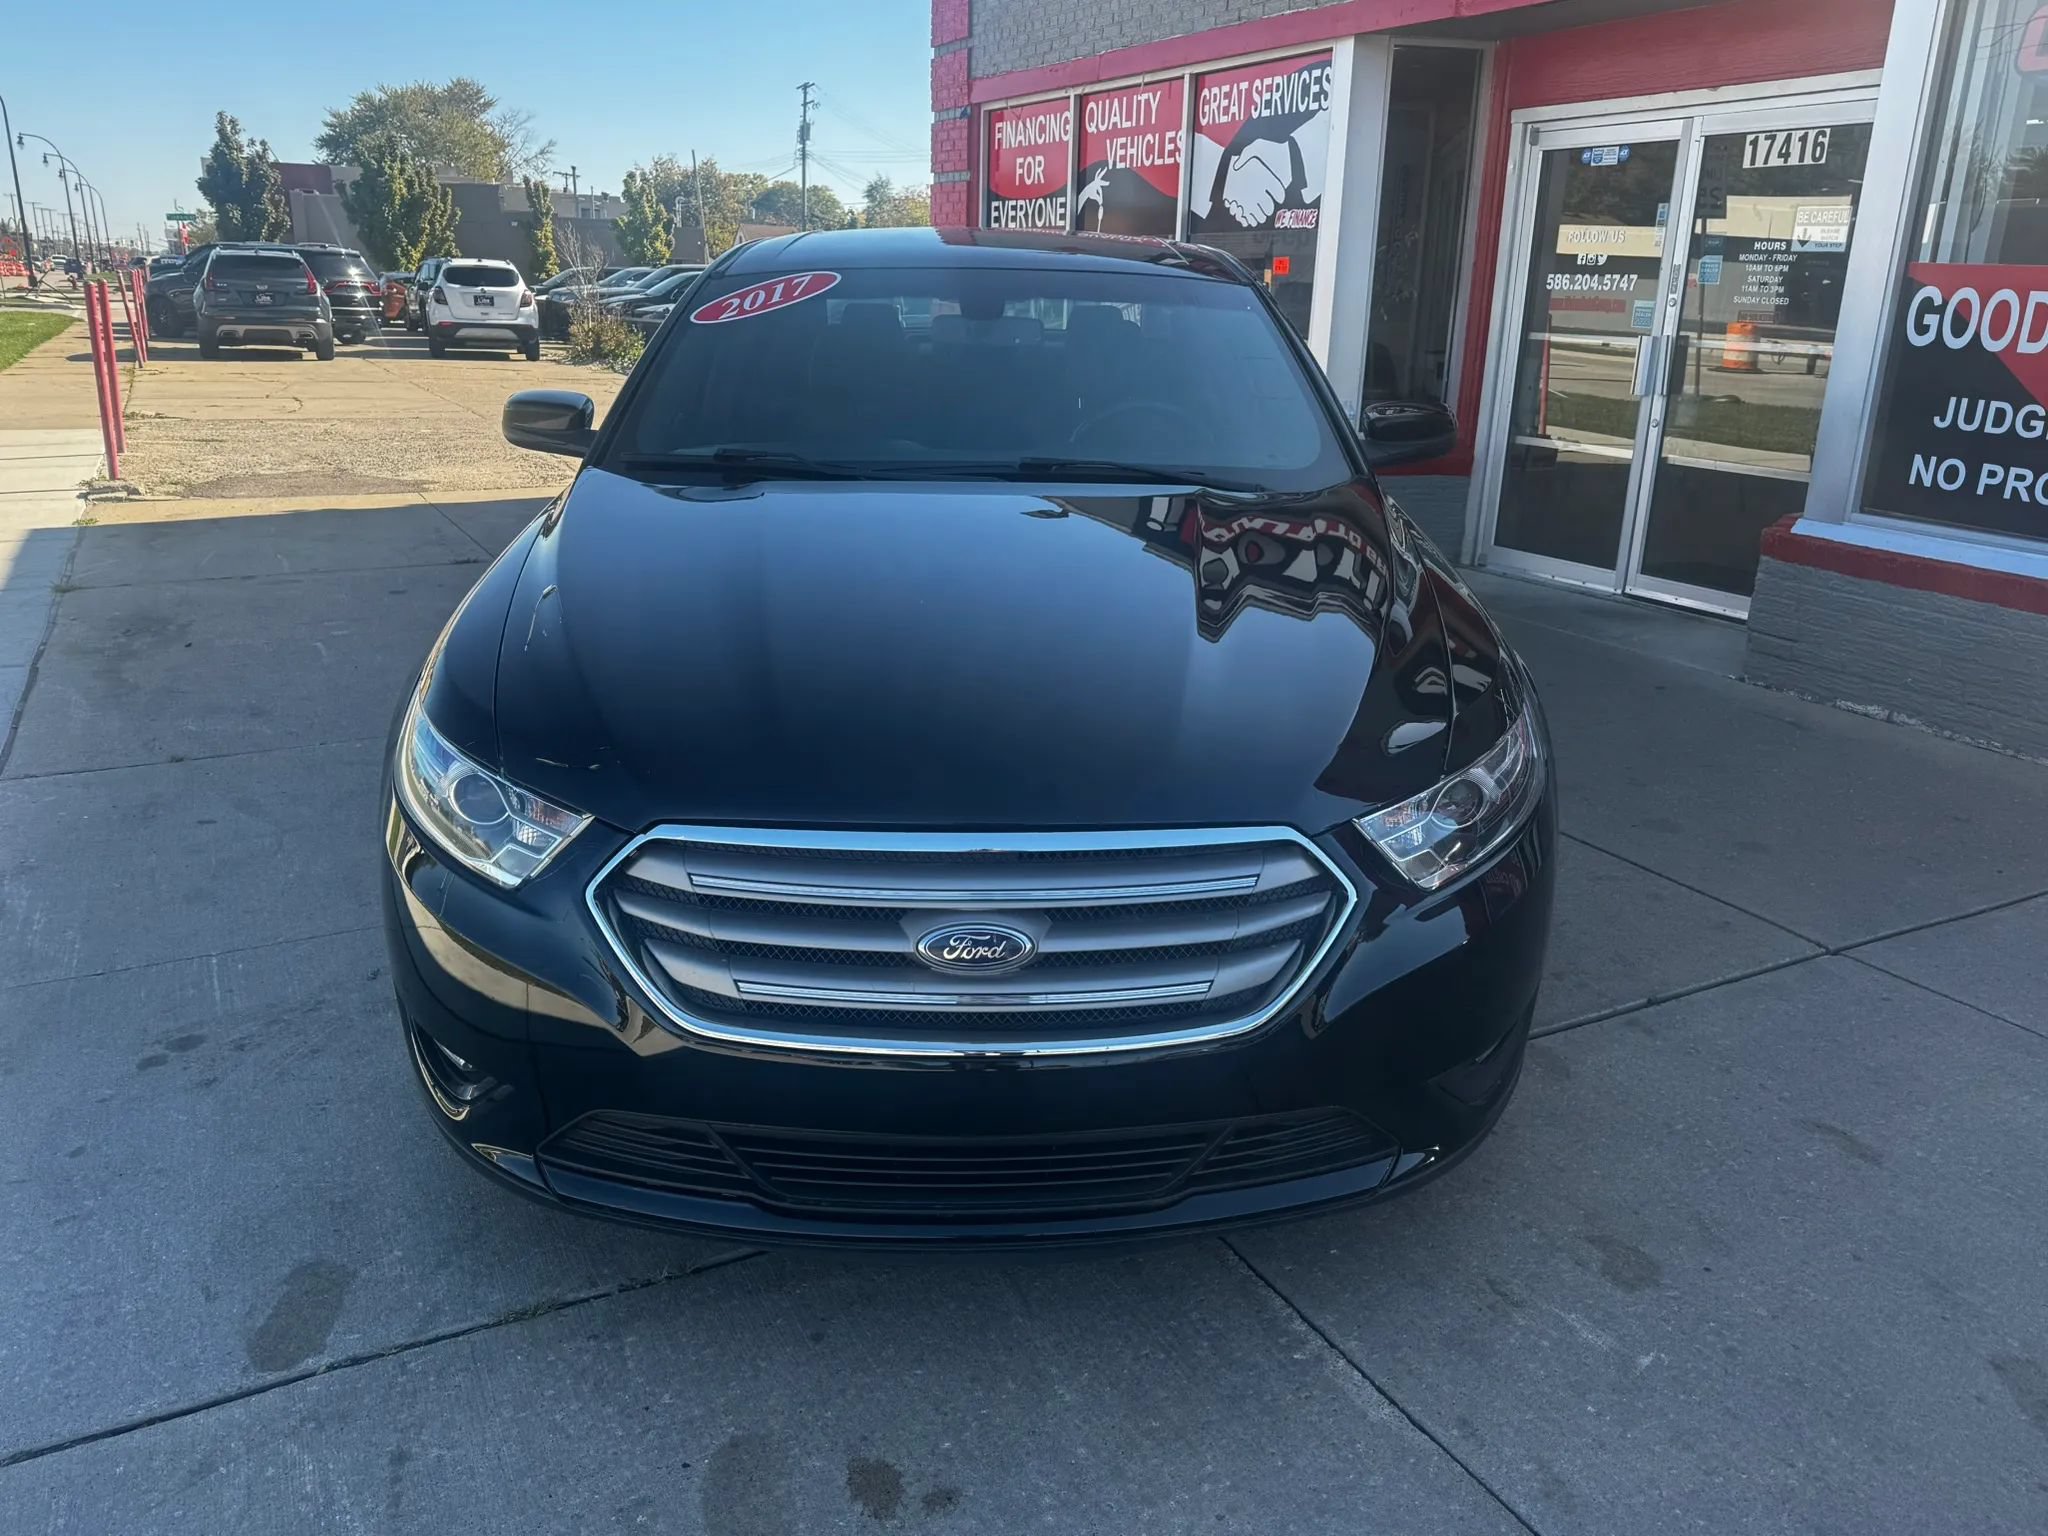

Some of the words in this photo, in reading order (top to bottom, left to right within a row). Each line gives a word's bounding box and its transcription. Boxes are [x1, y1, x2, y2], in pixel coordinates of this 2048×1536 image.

[1085, 90, 1161, 133] QUALITY
[1200, 81, 1249, 126] GREAT
[1251, 66, 1332, 119] SERVICES
[995, 110, 1071, 150] FINANCING
[1106, 128, 1185, 170] VEHICLES
[1748, 129, 1828, 167] 17416
[1015, 155, 1045, 186] FOR
[991, 197, 1066, 229] EVERYONE
[1798, 211, 1809, 224] BE
[1810, 210, 1850, 225] CAREFUL
[1567, 230, 1609, 243] FOLLOW
[1611, 229, 1626, 243] US
[1754, 241, 1787, 250] HOURS
[1739, 253, 1768, 261] MONDAY
[1772, 254, 1798, 262] FRIDAY
[1764, 264, 1774, 272] TO
[1546, 273, 1638, 291] 586.204.5747
[1747, 275, 1783, 283] SATURDAY
[1760, 285, 1769, 293] TO
[718, 274, 814, 320] 2017
[1733, 295, 1760, 304] SUNDAY
[1761, 297, 1789, 305] CLOSED
[1906, 285, 2048, 354] GOOD
[1933, 396, 2048, 440] JUDG
[1908, 453, 1966, 491] NO
[942, 934, 1007, 960] Ford
